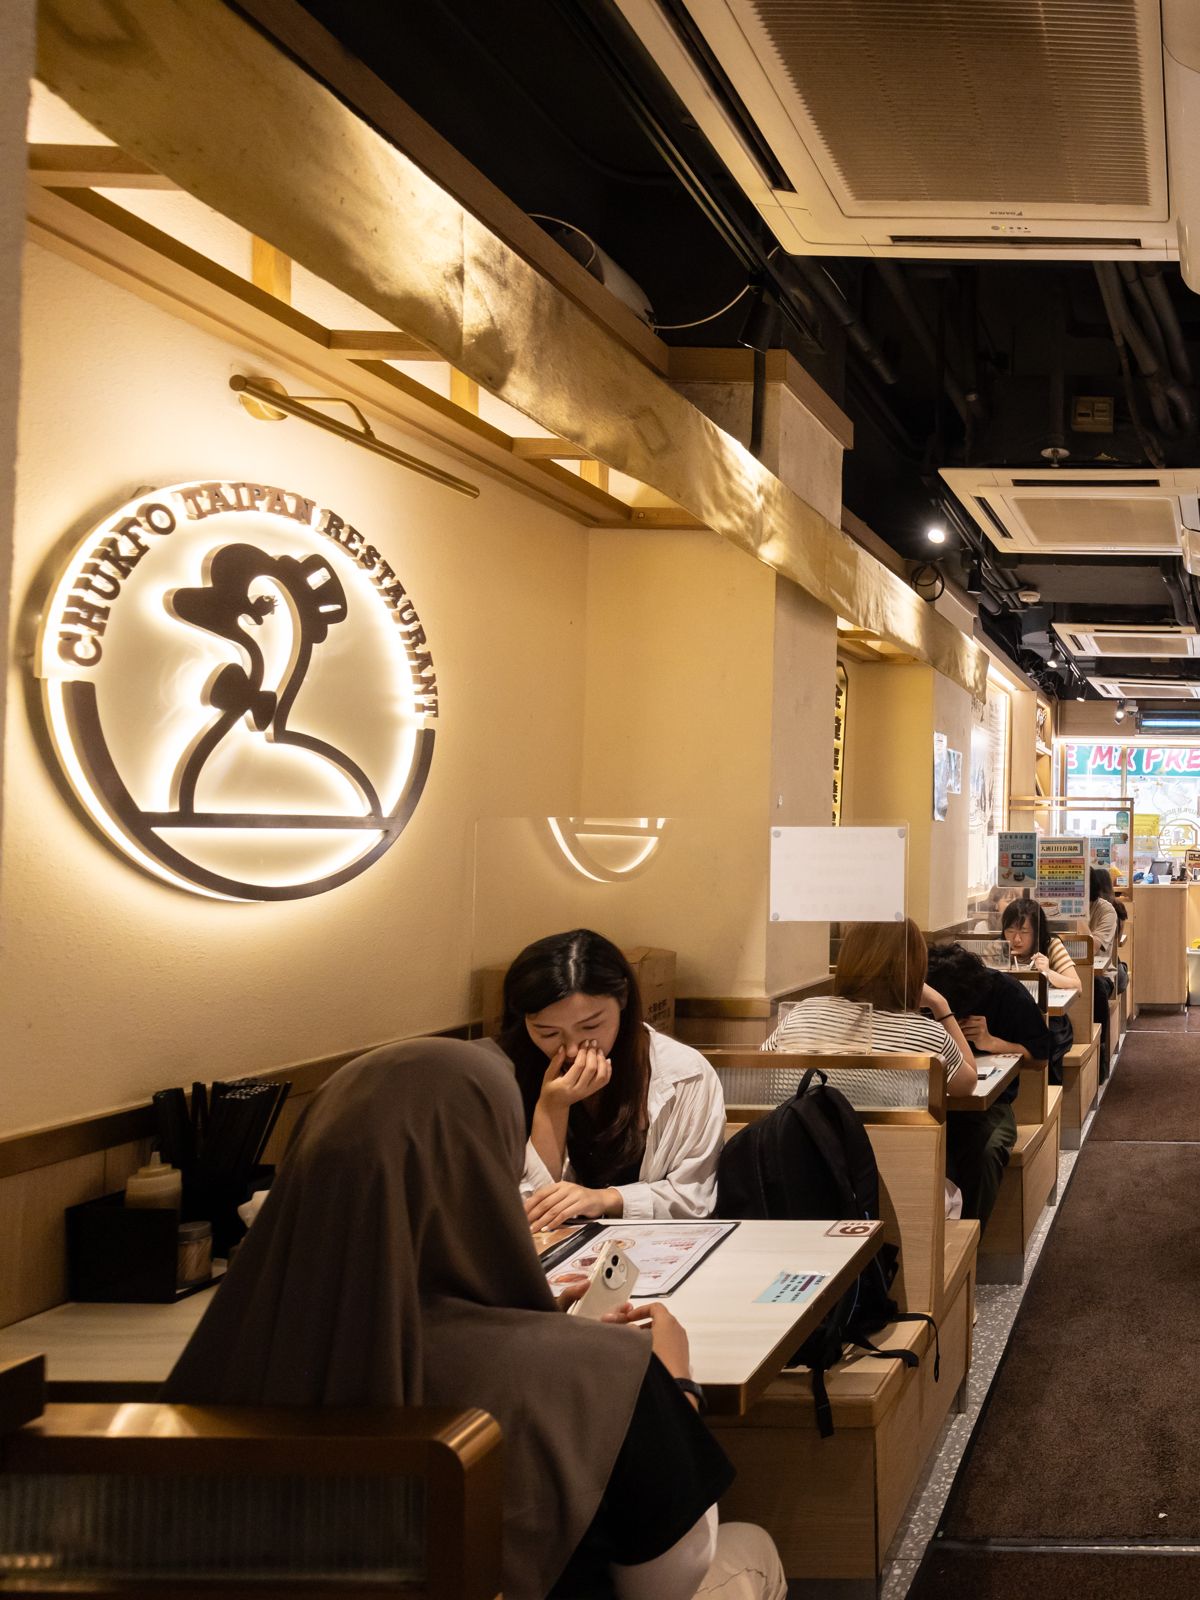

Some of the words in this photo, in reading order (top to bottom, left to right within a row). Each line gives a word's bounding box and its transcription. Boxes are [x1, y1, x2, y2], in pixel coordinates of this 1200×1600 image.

[58, 503, 176, 667] CHUKFO
[174, 482, 316, 525] TAIPAN
[321, 509, 439, 718] RESTAURANT
